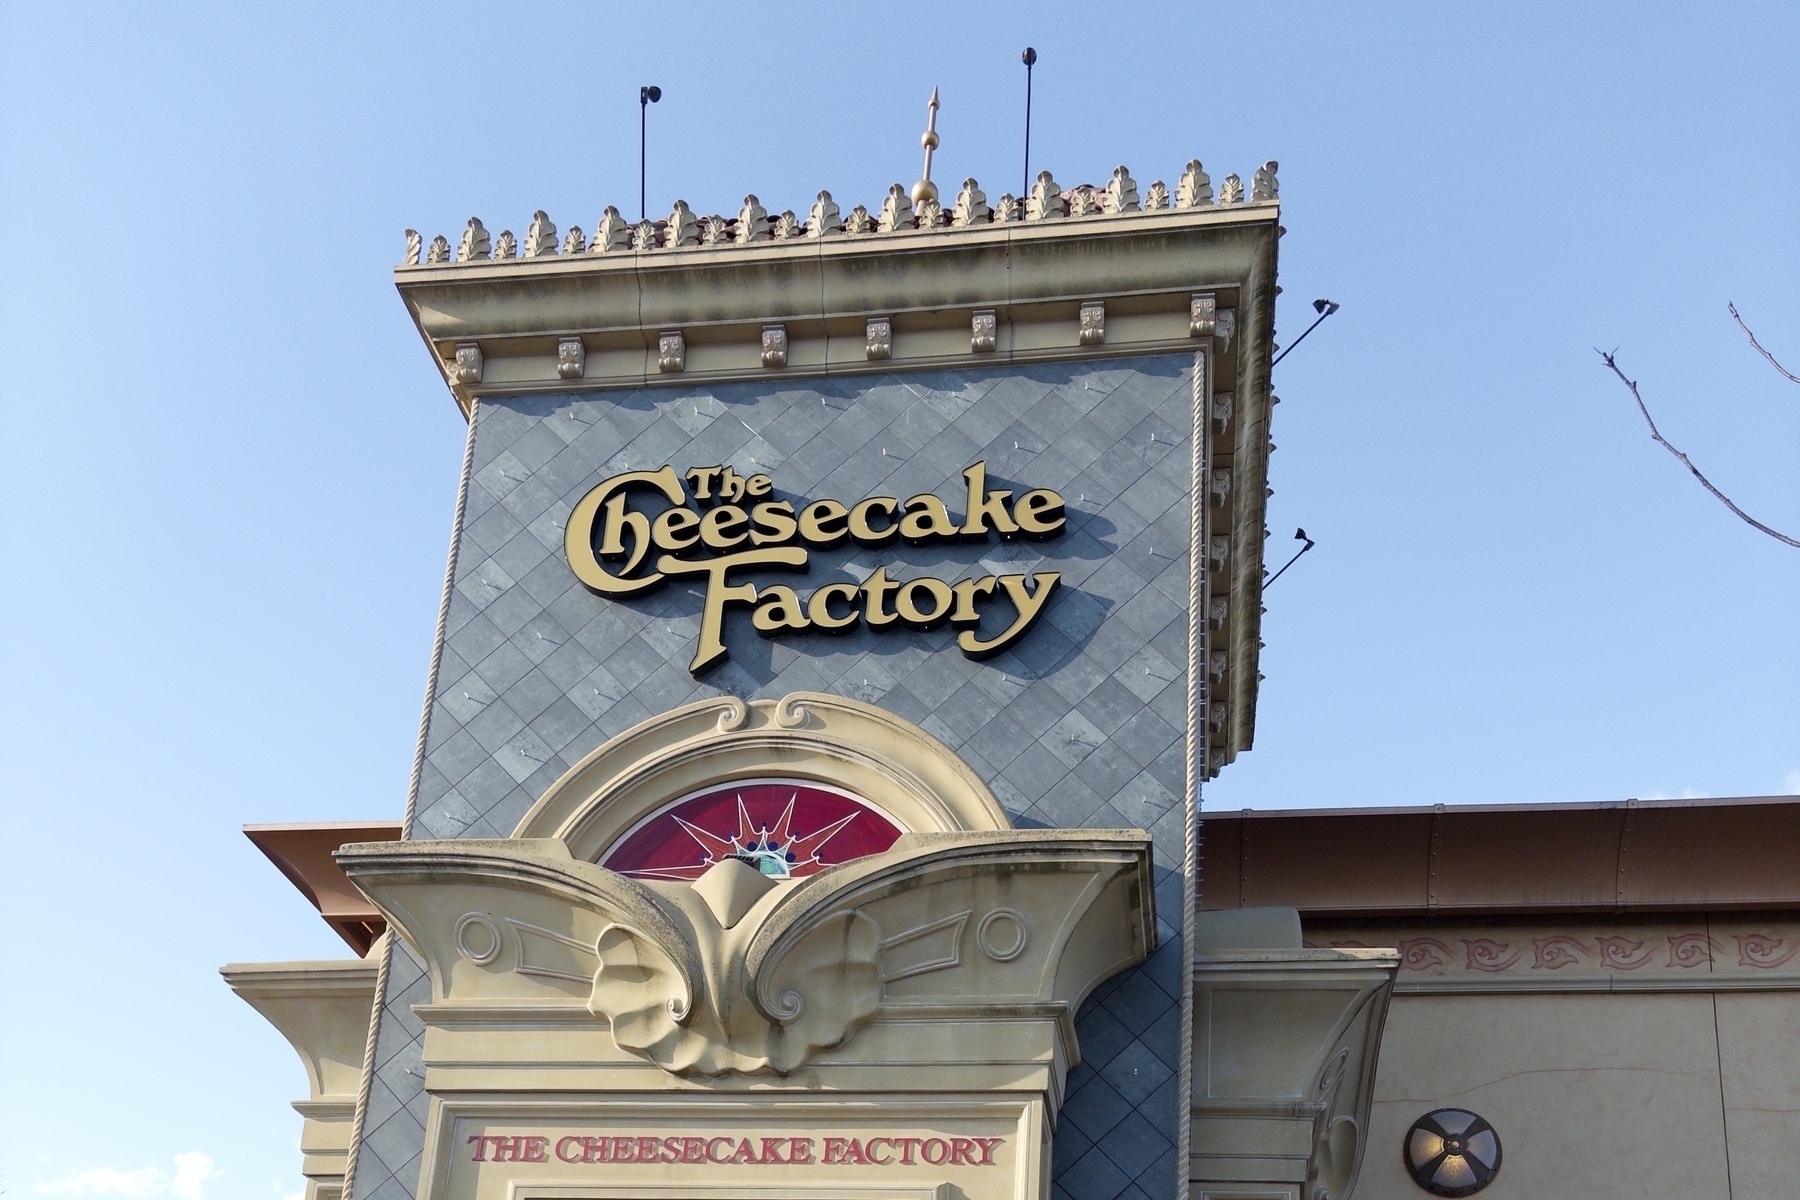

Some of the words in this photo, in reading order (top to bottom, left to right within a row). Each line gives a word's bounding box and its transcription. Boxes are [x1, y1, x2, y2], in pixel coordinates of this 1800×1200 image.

[686, 464, 774, 503] The
[564, 460, 1067, 599] Cheesecake
[656, 546, 1062, 679] Factory
[468, 1135, 549, 1163] THE
[555, 1135, 814, 1165] CHEESECAKE
[821, 1136, 1004, 1166] FACTORY
